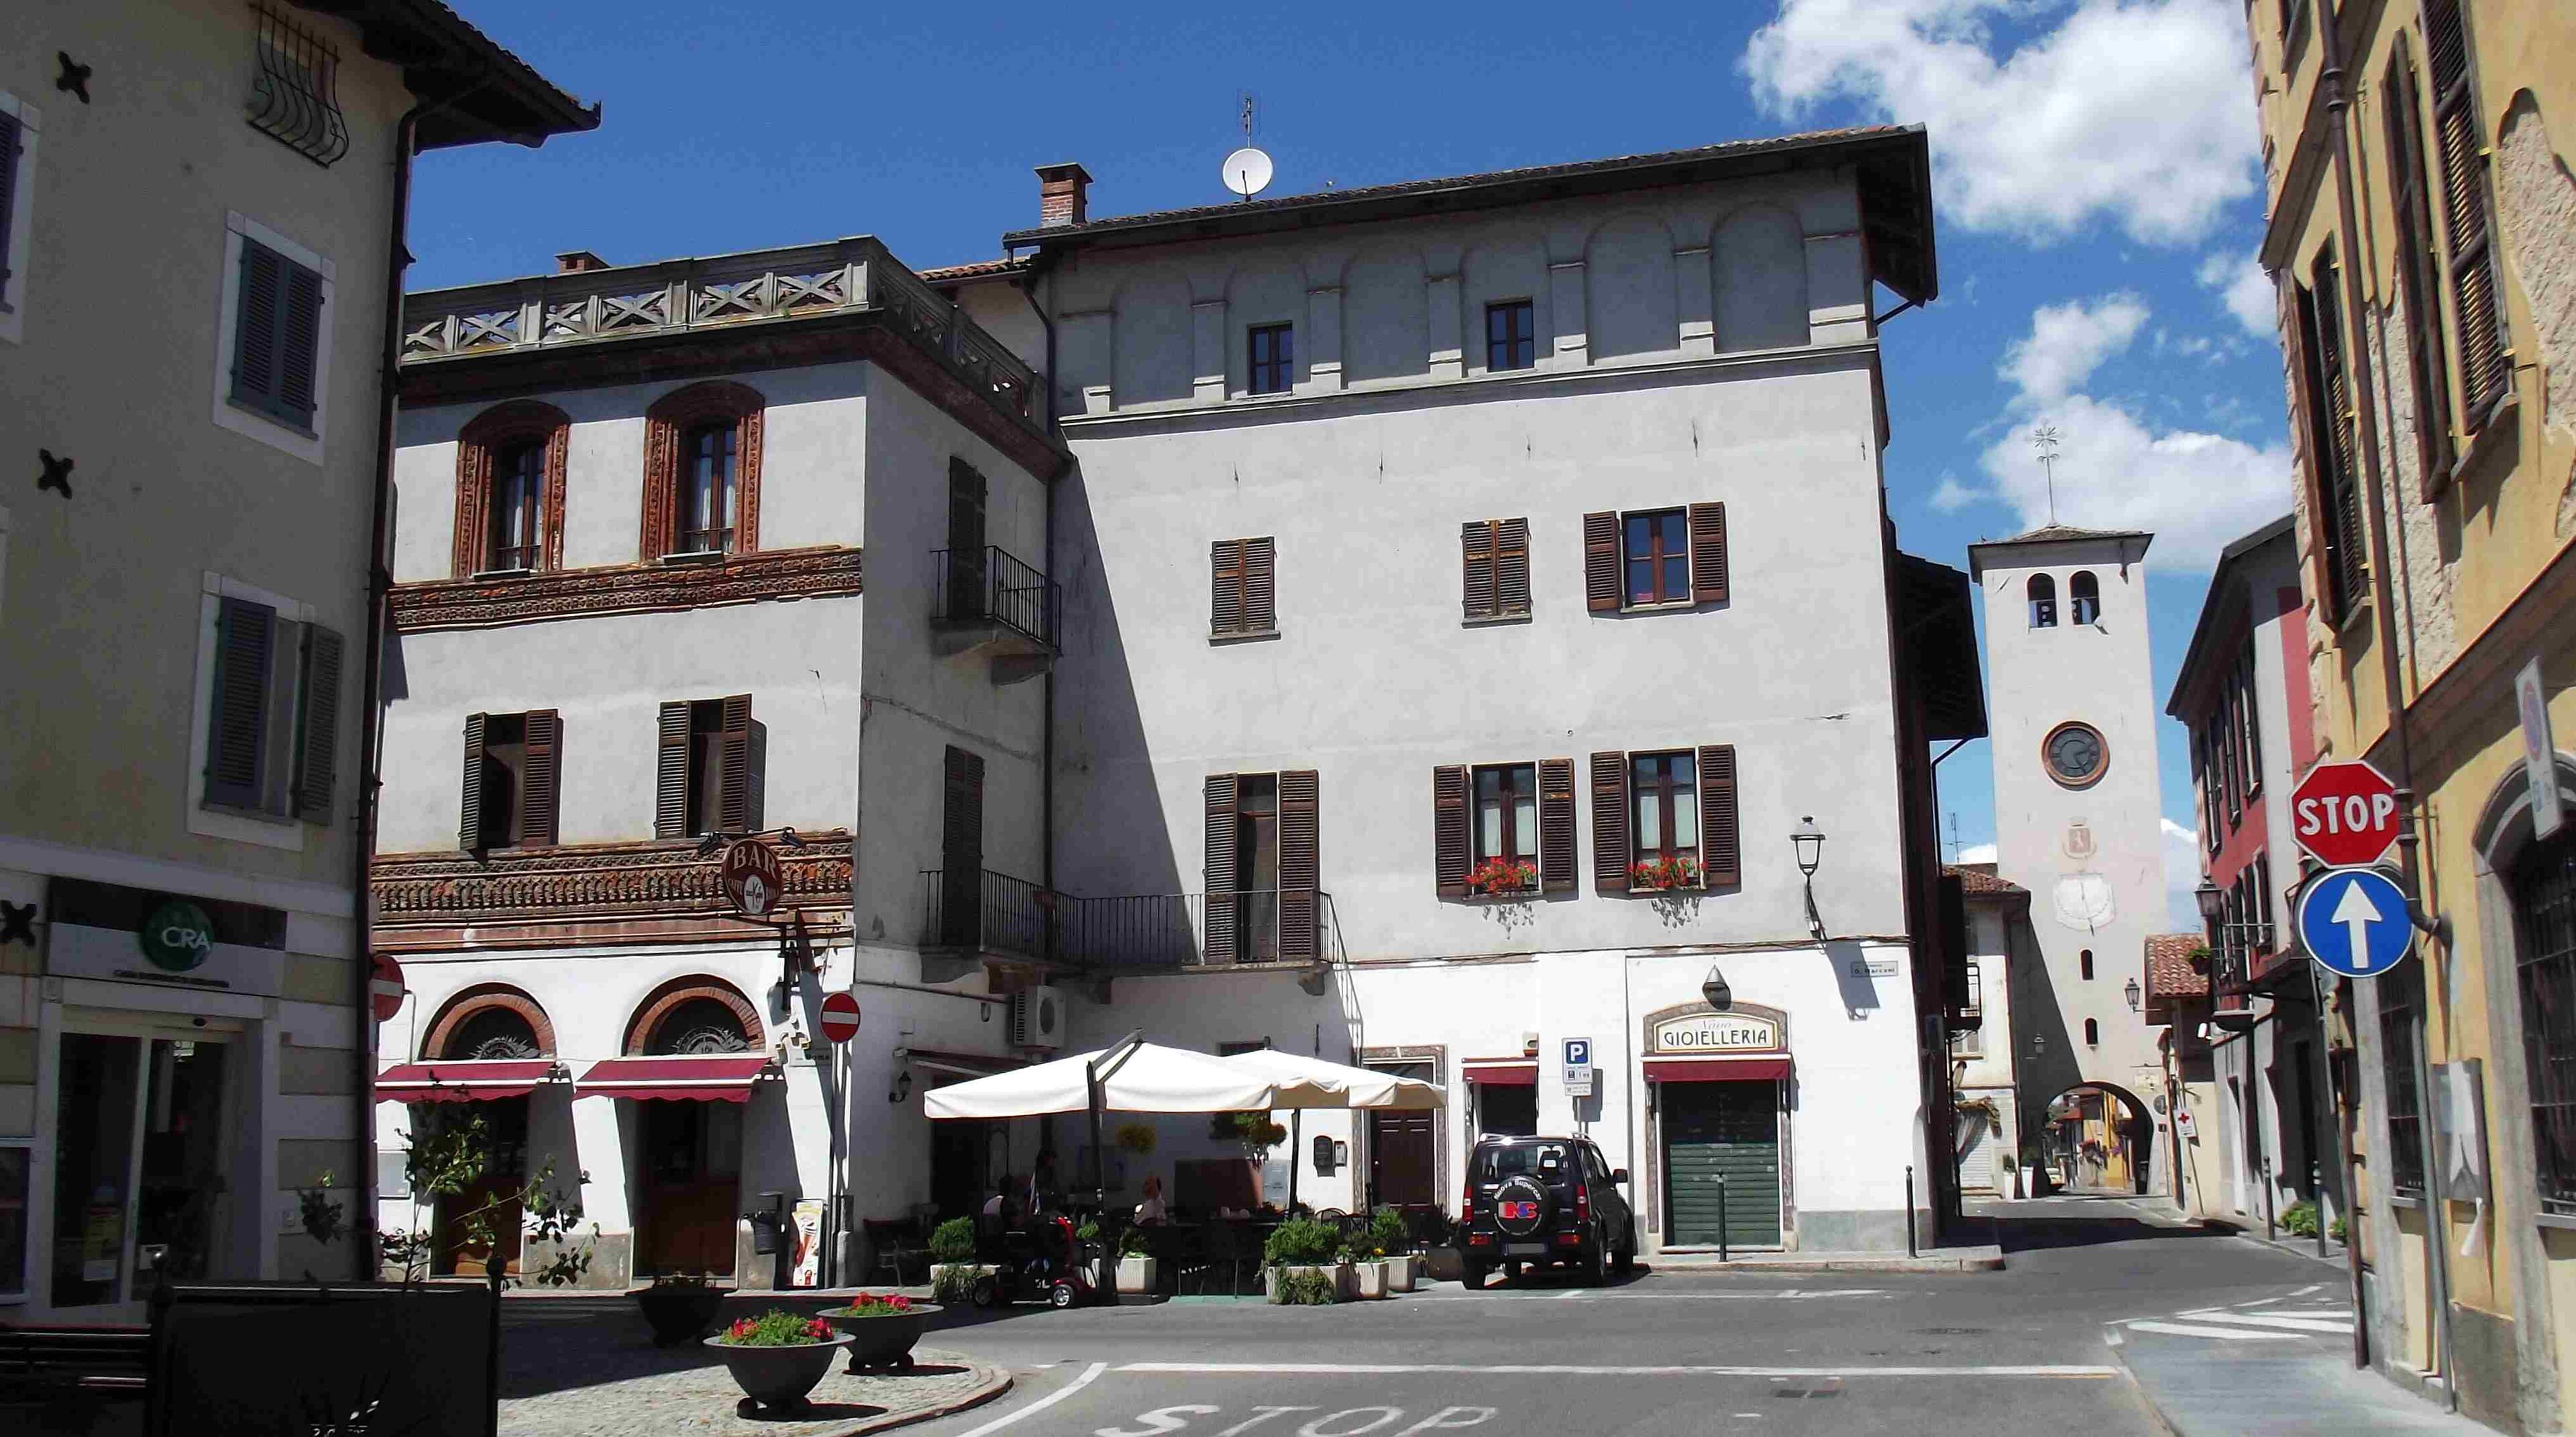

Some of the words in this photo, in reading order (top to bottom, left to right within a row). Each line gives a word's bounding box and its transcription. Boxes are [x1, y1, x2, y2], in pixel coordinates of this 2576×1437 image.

[2297, 794, 2395, 836] STOP
[733, 845, 777, 881] BAR
[161, 926, 211, 951] CRA
[1664, 1028, 1767, 1047] GIOIELLERIA
[1570, 1044, 1584, 1061] P
[1494, 1181, 1512, 1200] Nuova
[1094, 1404, 1497, 1437] STOP
